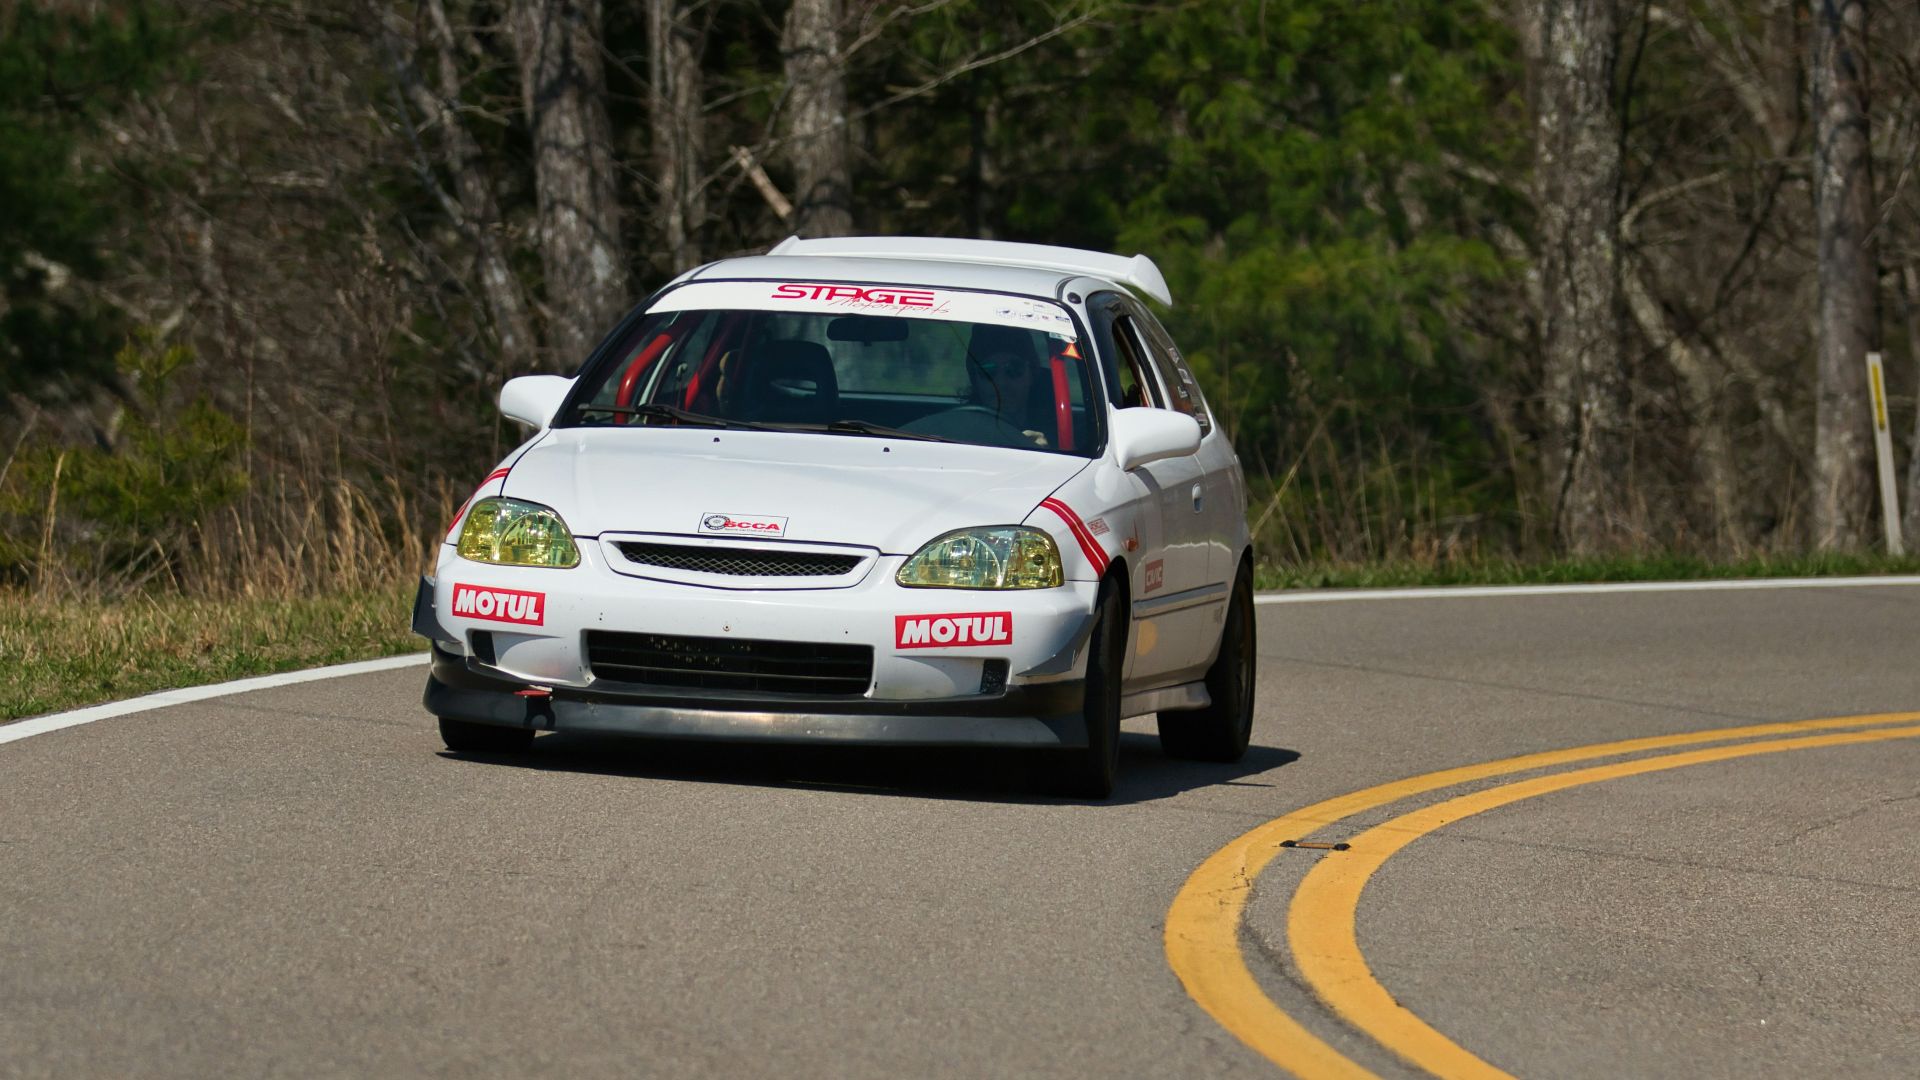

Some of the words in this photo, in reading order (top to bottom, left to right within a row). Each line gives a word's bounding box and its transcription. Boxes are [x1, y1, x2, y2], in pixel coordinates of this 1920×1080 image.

[771, 284, 935, 307] STAGE
[724, 521, 780, 531] SCCA
[455, 589, 540, 621] MOTUL
[900, 616, 1008, 645] MOTUL
